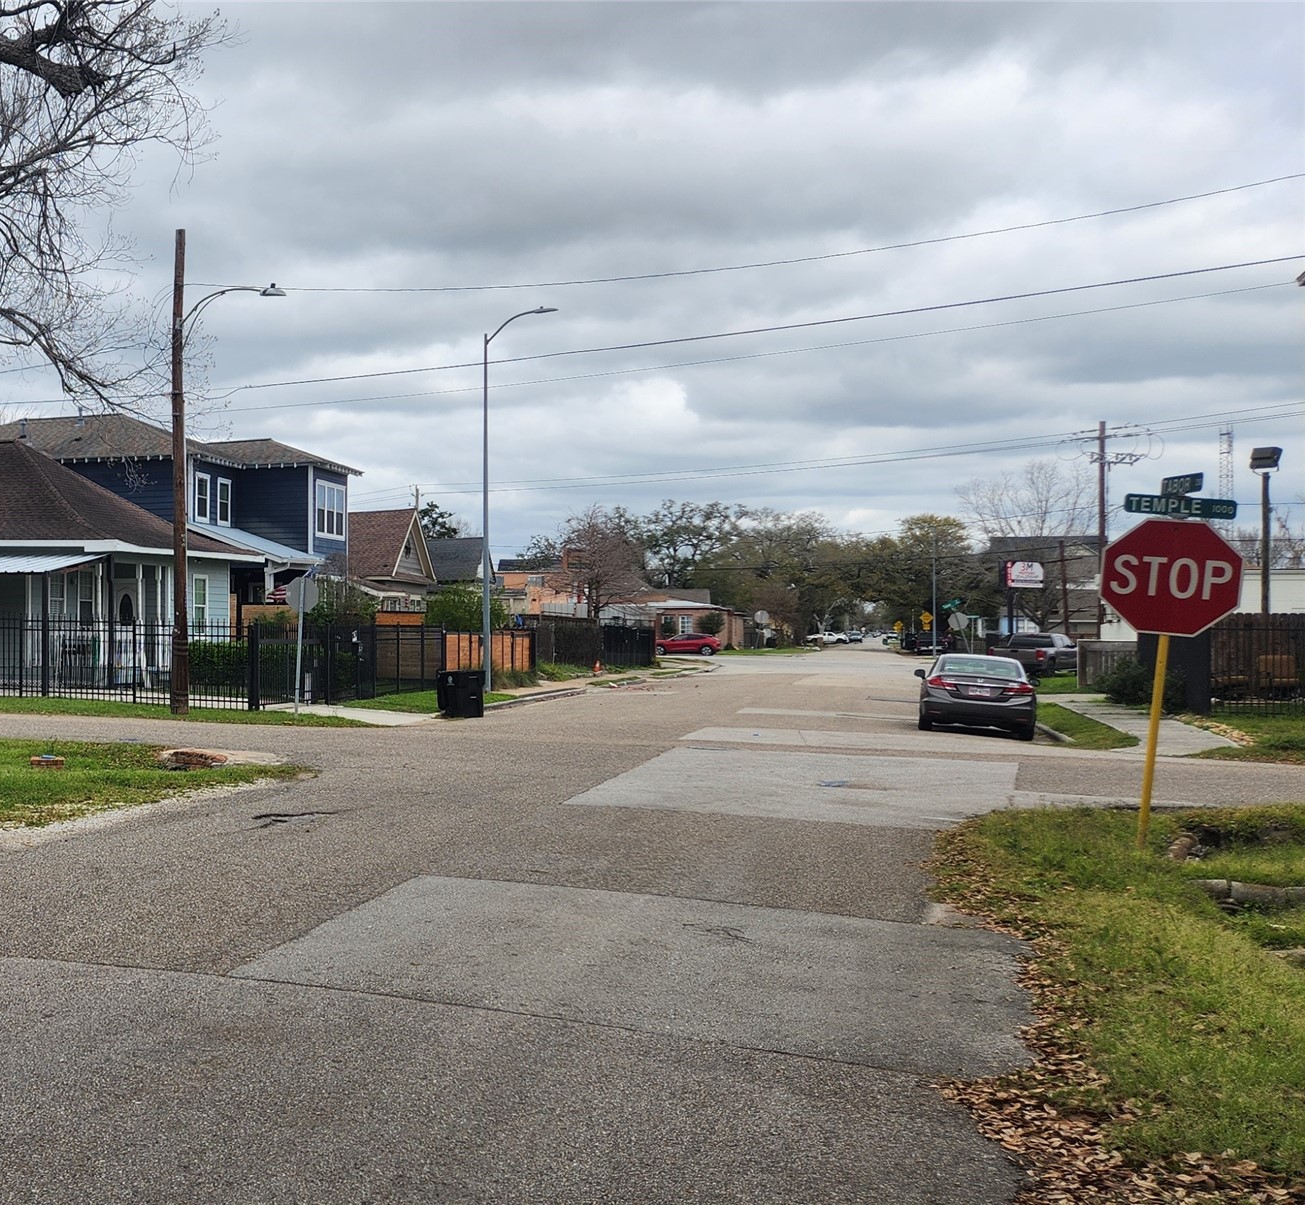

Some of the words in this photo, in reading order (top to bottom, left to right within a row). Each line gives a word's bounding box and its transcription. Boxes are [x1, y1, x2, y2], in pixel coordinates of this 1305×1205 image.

[1162, 477, 1191, 495] TABOR
[1129, 497, 1202, 514] TEMPLE
[1212, 505, 1234, 514] 1000
[1021, 562, 1033, 571] 3M
[1110, 554, 1233, 600] STOP
